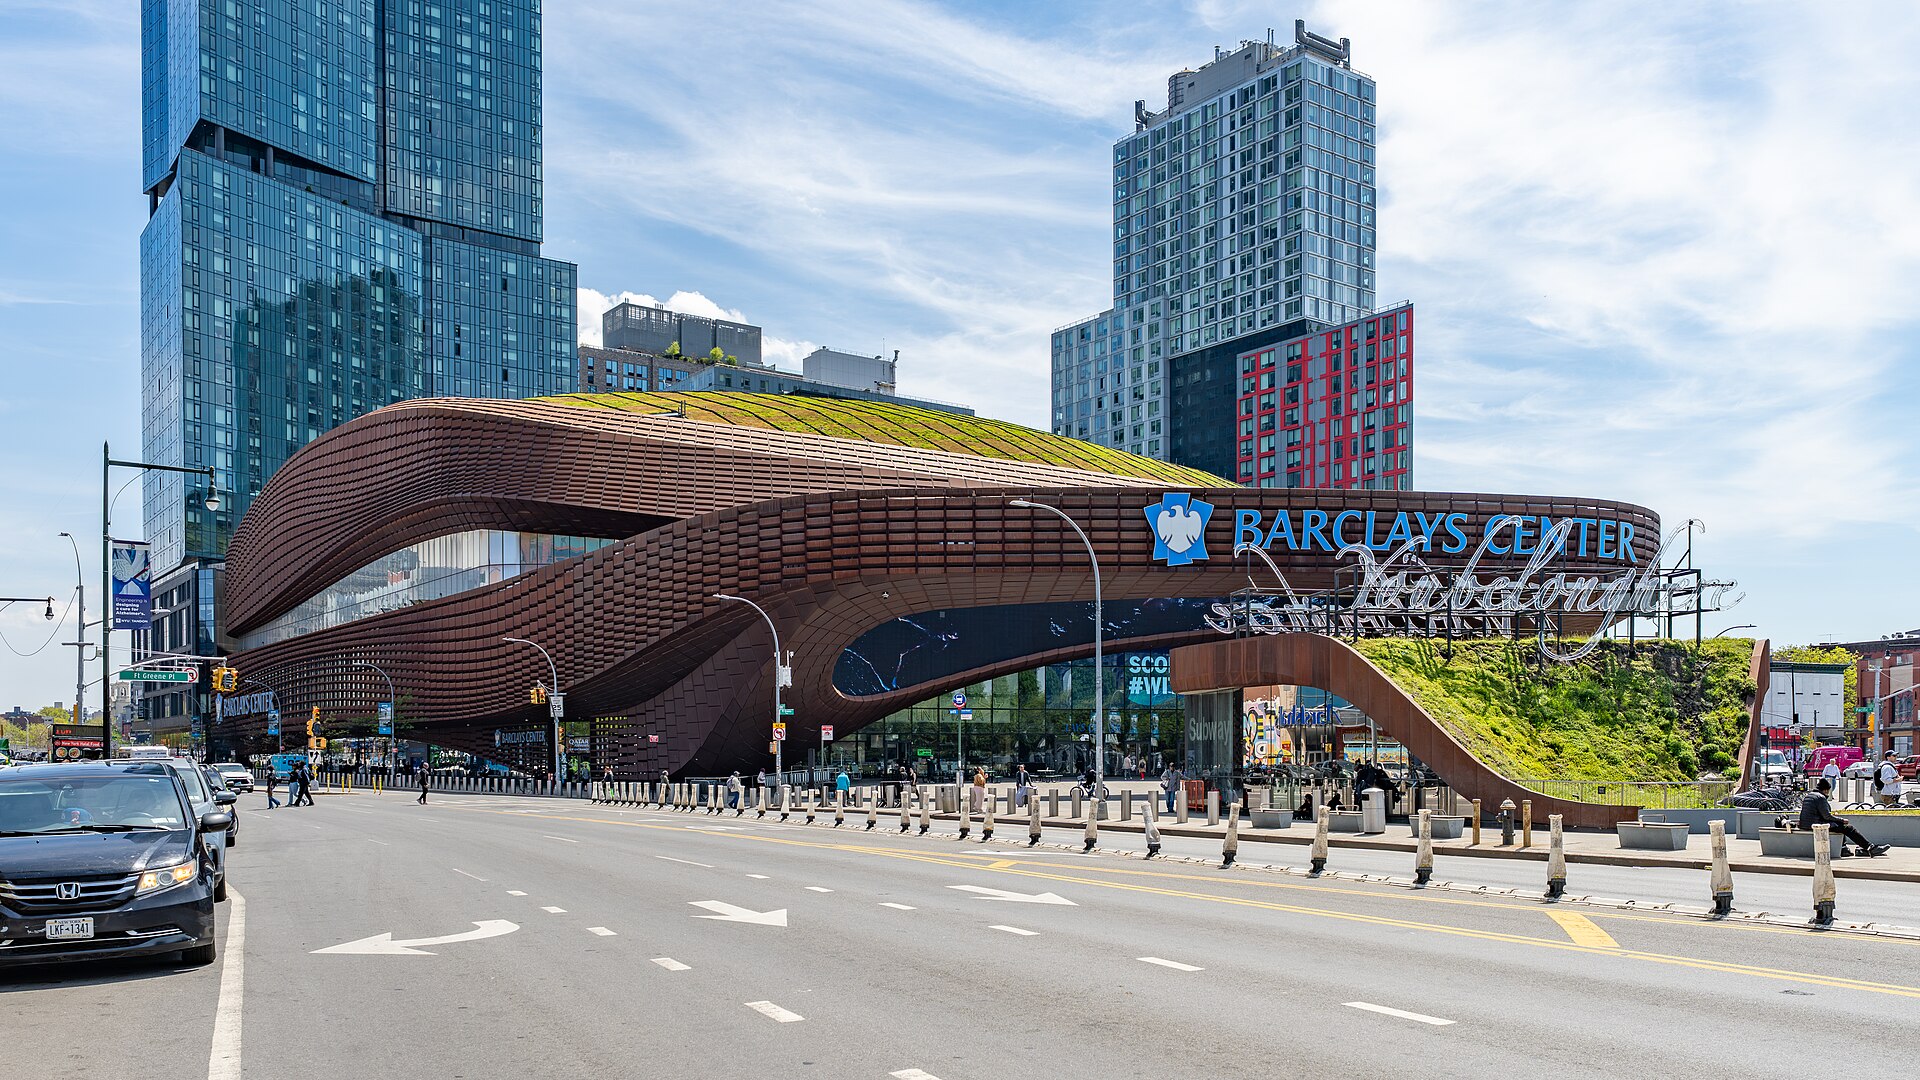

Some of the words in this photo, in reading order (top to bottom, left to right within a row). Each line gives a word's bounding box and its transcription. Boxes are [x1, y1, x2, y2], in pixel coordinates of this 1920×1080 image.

[1233, 509, 1468, 553] BARCLAYS
[1484, 513, 1638, 563] CENTER
[223, 694, 250, 717] BARCLAYS
[250, 691, 275, 713] CENTER
[501, 731, 526, 744] BARCLAYS
[525, 730, 546, 743] CENTER
[1189, 716, 1230, 746] Subway
